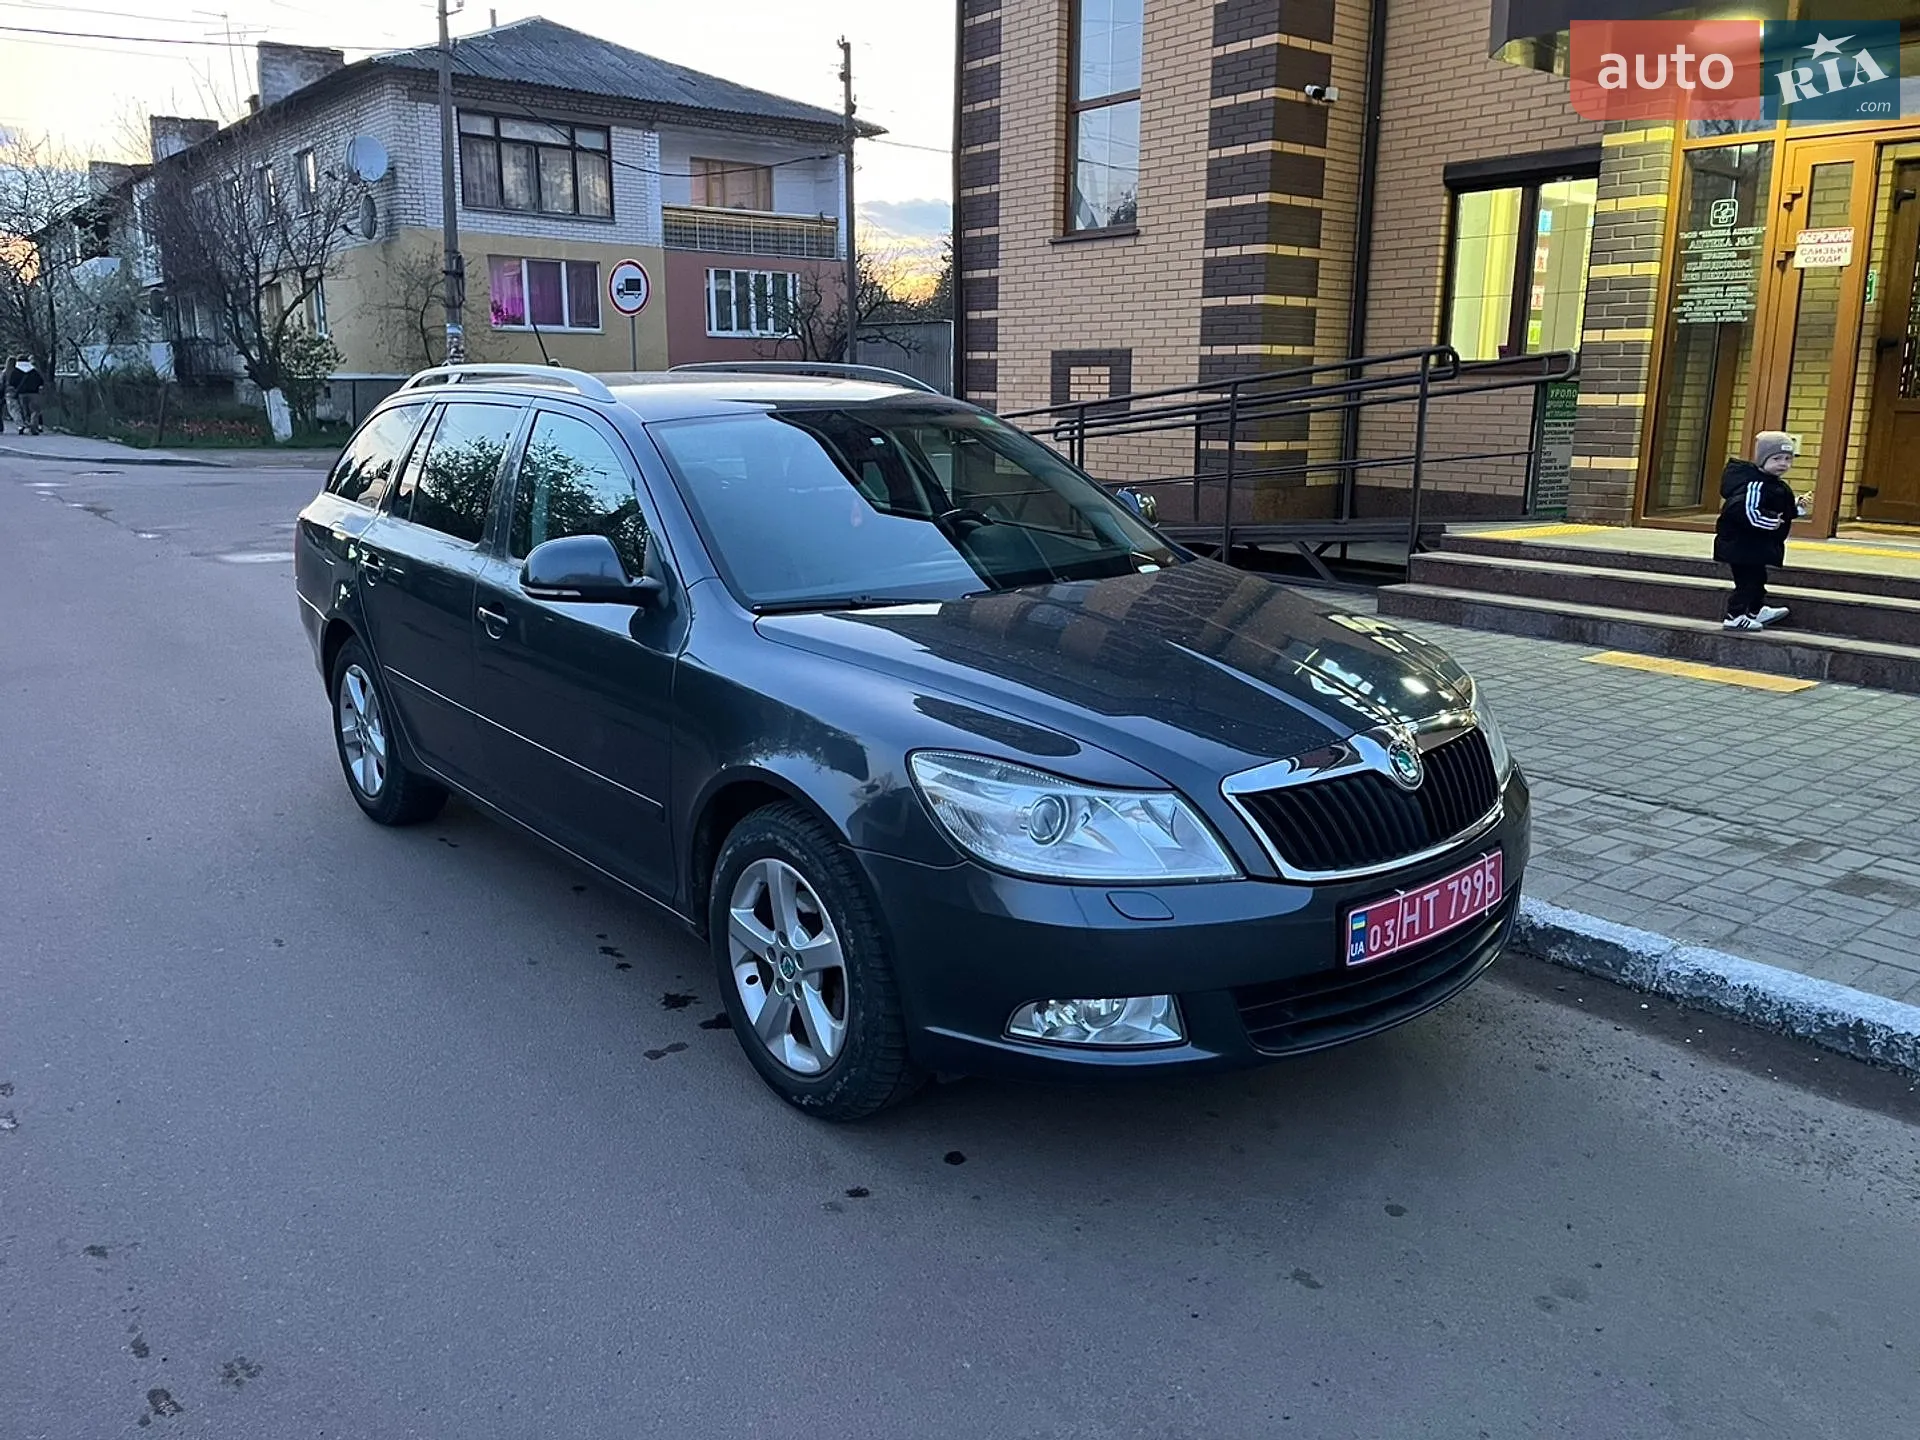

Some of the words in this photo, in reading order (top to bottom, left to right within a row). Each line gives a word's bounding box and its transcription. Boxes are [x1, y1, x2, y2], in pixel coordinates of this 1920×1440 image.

[1800, 246, 1848, 256] СЛИЗЬКІ
[1804, 255, 1841, 264] СХОДИ
[1369, 918, 1395, 952] 03
[1402, 889, 1440, 940] HT
[1447, 861, 1496, 920] 7995
[1350, 941, 1365, 957] UA
